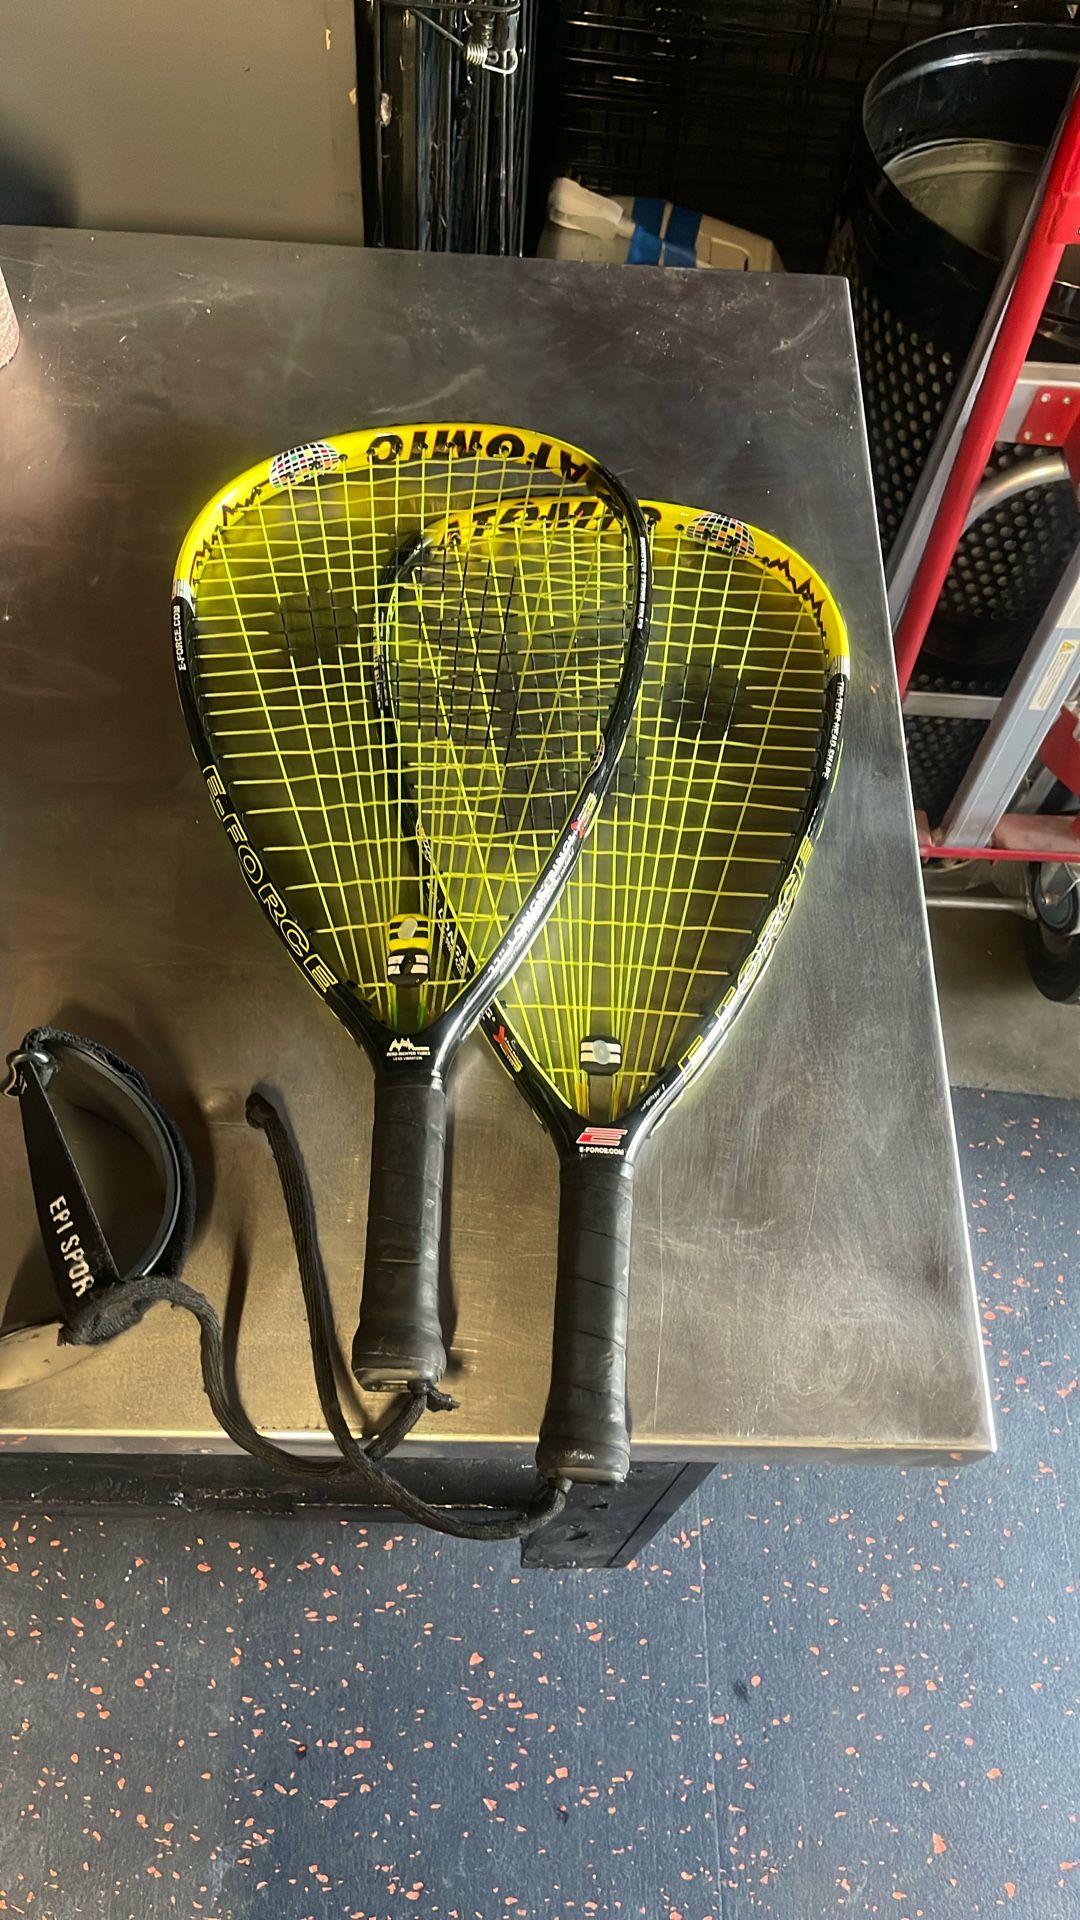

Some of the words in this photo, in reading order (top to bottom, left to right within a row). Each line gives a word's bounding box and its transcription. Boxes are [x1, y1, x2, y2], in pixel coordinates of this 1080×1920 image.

[369, 428, 589, 483] ATOMIC
[639, 536, 648, 571] MONSTER
[639, 573, 647, 601] STRING
[637, 602, 646, 629] HOLES
[173, 604, 186, 671] E-FORCE.COM
[828, 722, 840, 747] HEAD
[821, 748, 835, 780] SHAPE
[202, 764, 339, 993] E-FORCE
[578, 1146, 625, 1156] E-FORCE.COM
[49, 1195, 74, 1236] EPI
